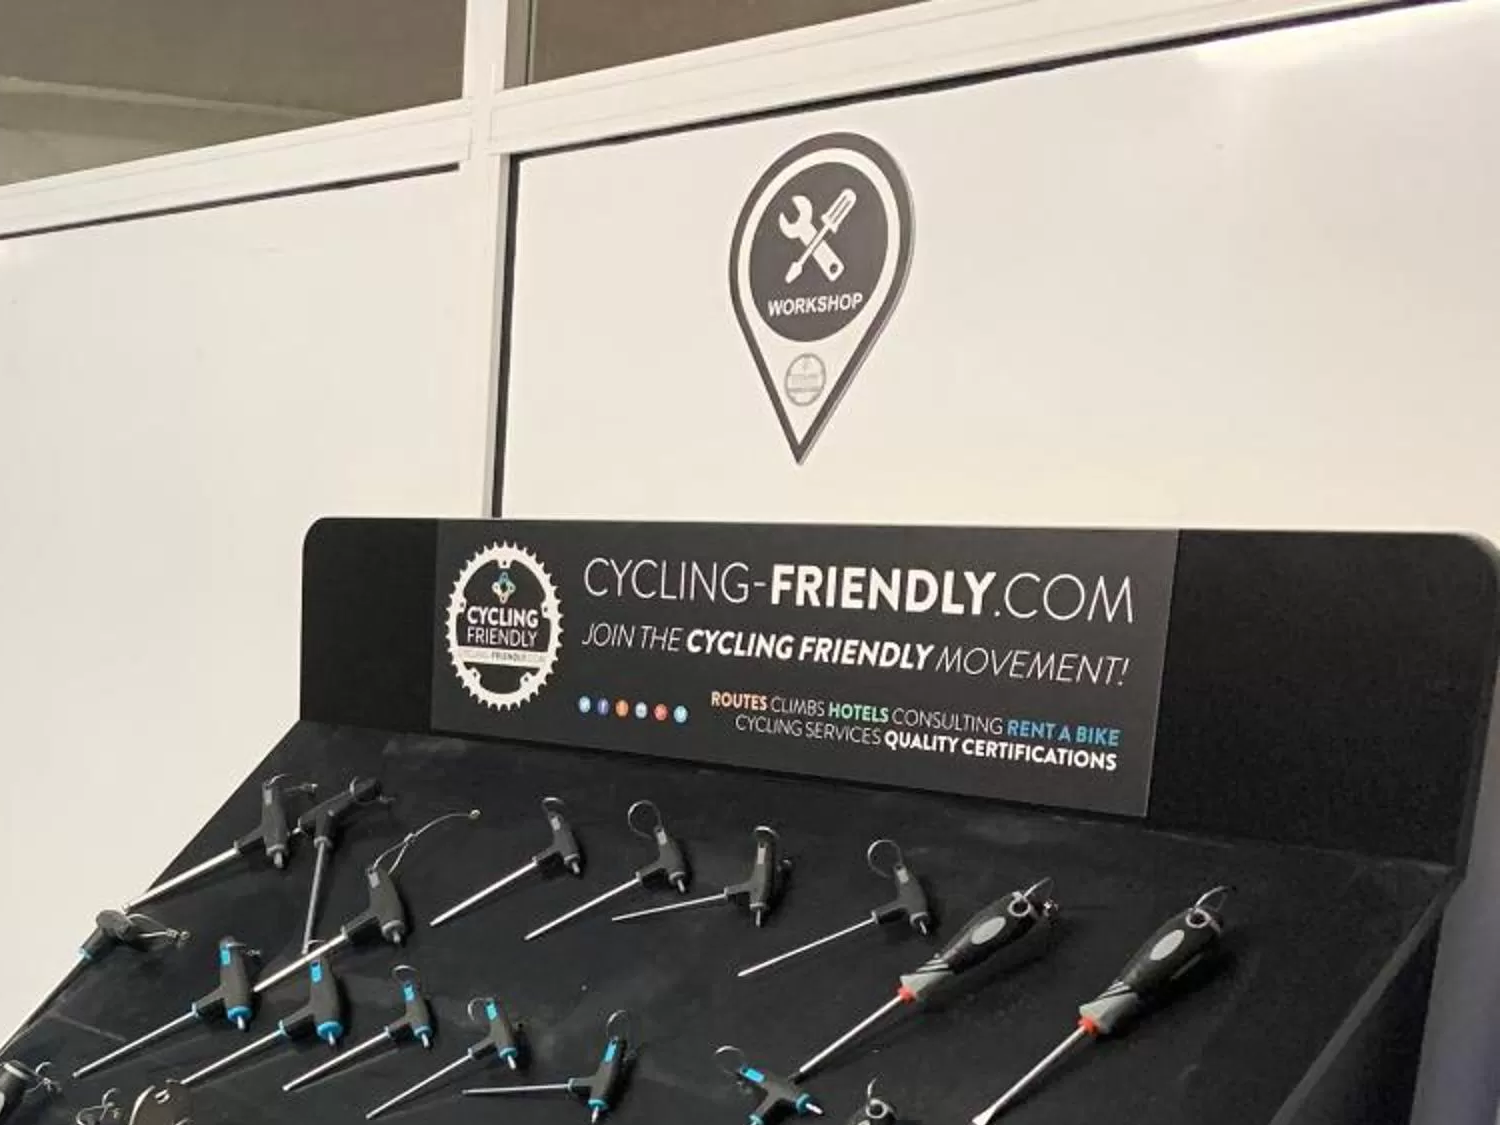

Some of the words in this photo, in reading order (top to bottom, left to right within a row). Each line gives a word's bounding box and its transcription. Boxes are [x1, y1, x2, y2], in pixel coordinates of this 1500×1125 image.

[767, 292, 863, 316] WORKSHOP
[467, 606, 539, 629] CYCLING
[584, 556, 1134, 624] CYCLING-FRIENDLY.COM
[467, 626, 538, 648] FRIENDLY
[582, 622, 635, 648] JOIN
[640, 625, 684, 651] THE
[686, 628, 794, 660] CYCLING
[798, 636, 934, 671] FRIENDLY
[935, 646, 1130, 687] MOVEMENT!
[711, 691, 768, 711] ROUTES
[770, 696, 825, 717] CLIMBS
[828, 701, 889, 723] HOTELS
[892, 707, 1003, 736] CONSULTING
[1007, 719, 1057, 740] RENT
[1058, 725, 1071, 742] A
[1076, 726, 1121, 747] BIKE
[735, 713, 802, 737] CYCLING
[805, 721, 882, 745] SERVICES
[884, 729, 959, 753] QUALITY
[962, 738, 1117, 771] CERTIFICATIONS
